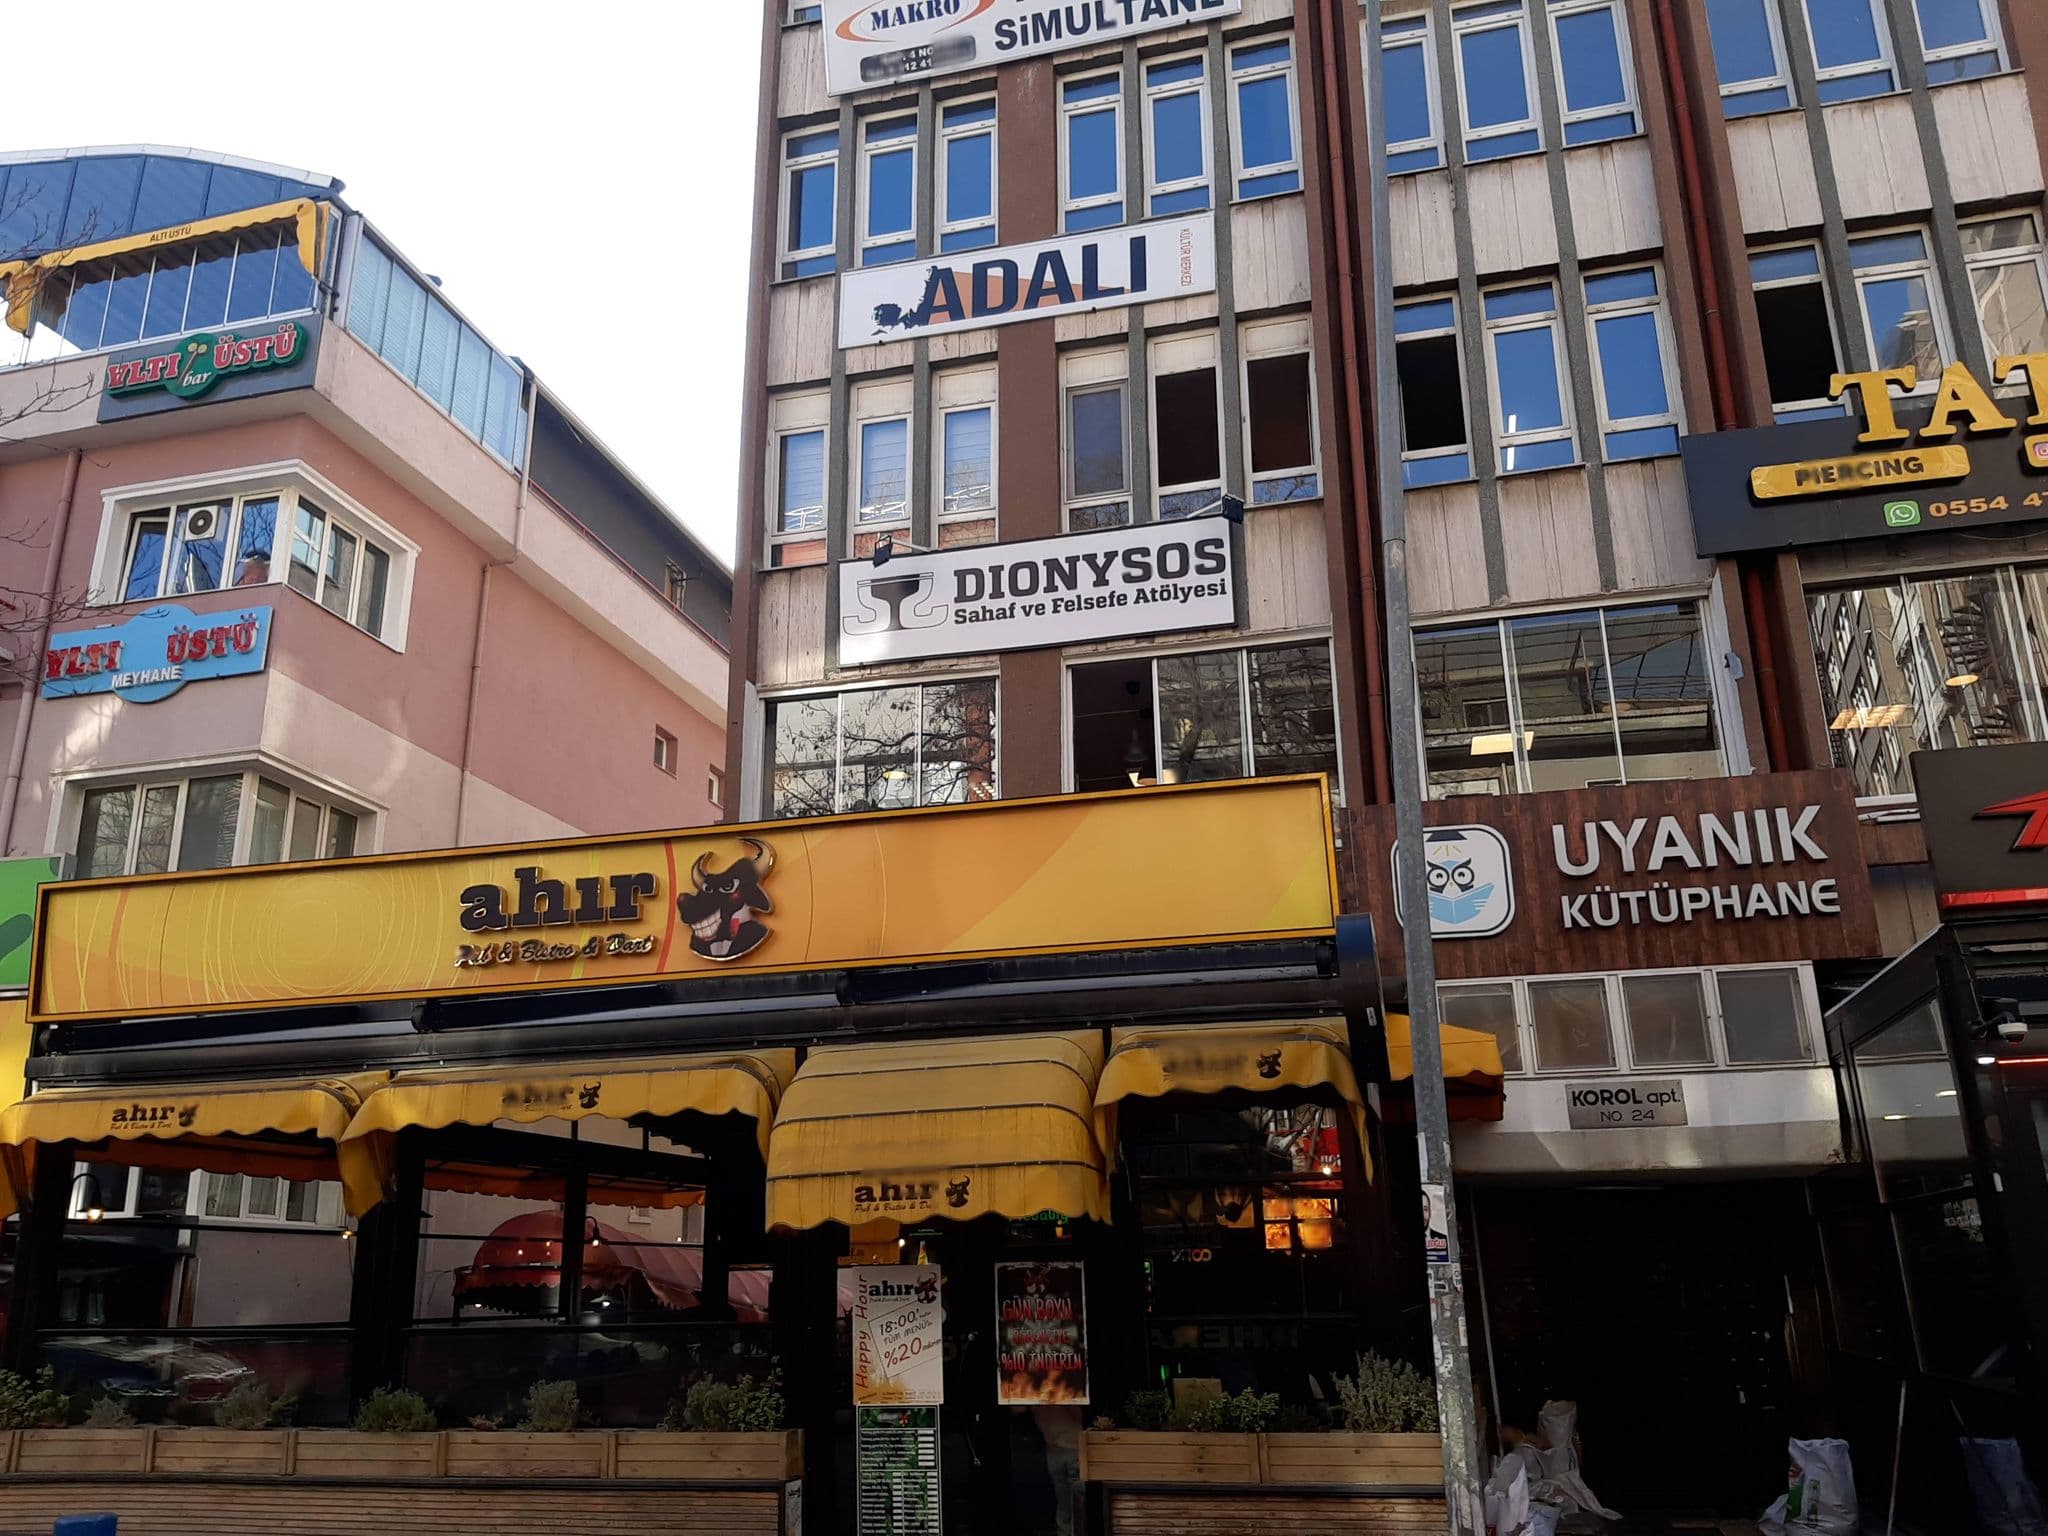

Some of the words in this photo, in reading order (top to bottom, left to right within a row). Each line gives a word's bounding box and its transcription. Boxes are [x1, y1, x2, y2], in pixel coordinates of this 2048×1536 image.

[870, 0, 961, 31] MAKRO
[919, 235, 1147, 326] ADALI
[213, 322, 297, 368] ÜSTÜ
[182, 370, 212, 387] bar
[1928, 495, 2009, 518] 0554
[2022, 490, 2048, 507] 4
[953, 538, 1226, 604] DIONYSOS
[954, 602, 1016, 625] Sahaf
[1021, 601, 1045, 617] ve
[1051, 591, 1128, 614] Felsefe
[1133, 578, 1227, 605] Atölyesi
[166, 613, 260, 664] ÜSTÜ
[111, 665, 183, 689] MEYHANE
[1552, 805, 1829, 876] UYANIK
[459, 866, 656, 933] ahır
[1561, 878, 1841, 929] KÜTÜPHANE
[498, 942, 514, 962] &
[520, 939, 576, 961] Bistro
[583, 936, 599, 960] &
[606, 932, 655, 955] Dart
[1571, 1087, 1642, 1107] KOROL
[1646, 1088, 1681, 1107] apt.
[1632, 1109, 1655, 1121] 24
[855, 1274, 868, 1320] Hour
[856, 1330, 872, 1389] Happy
[884, 1336, 922, 1368] %20
